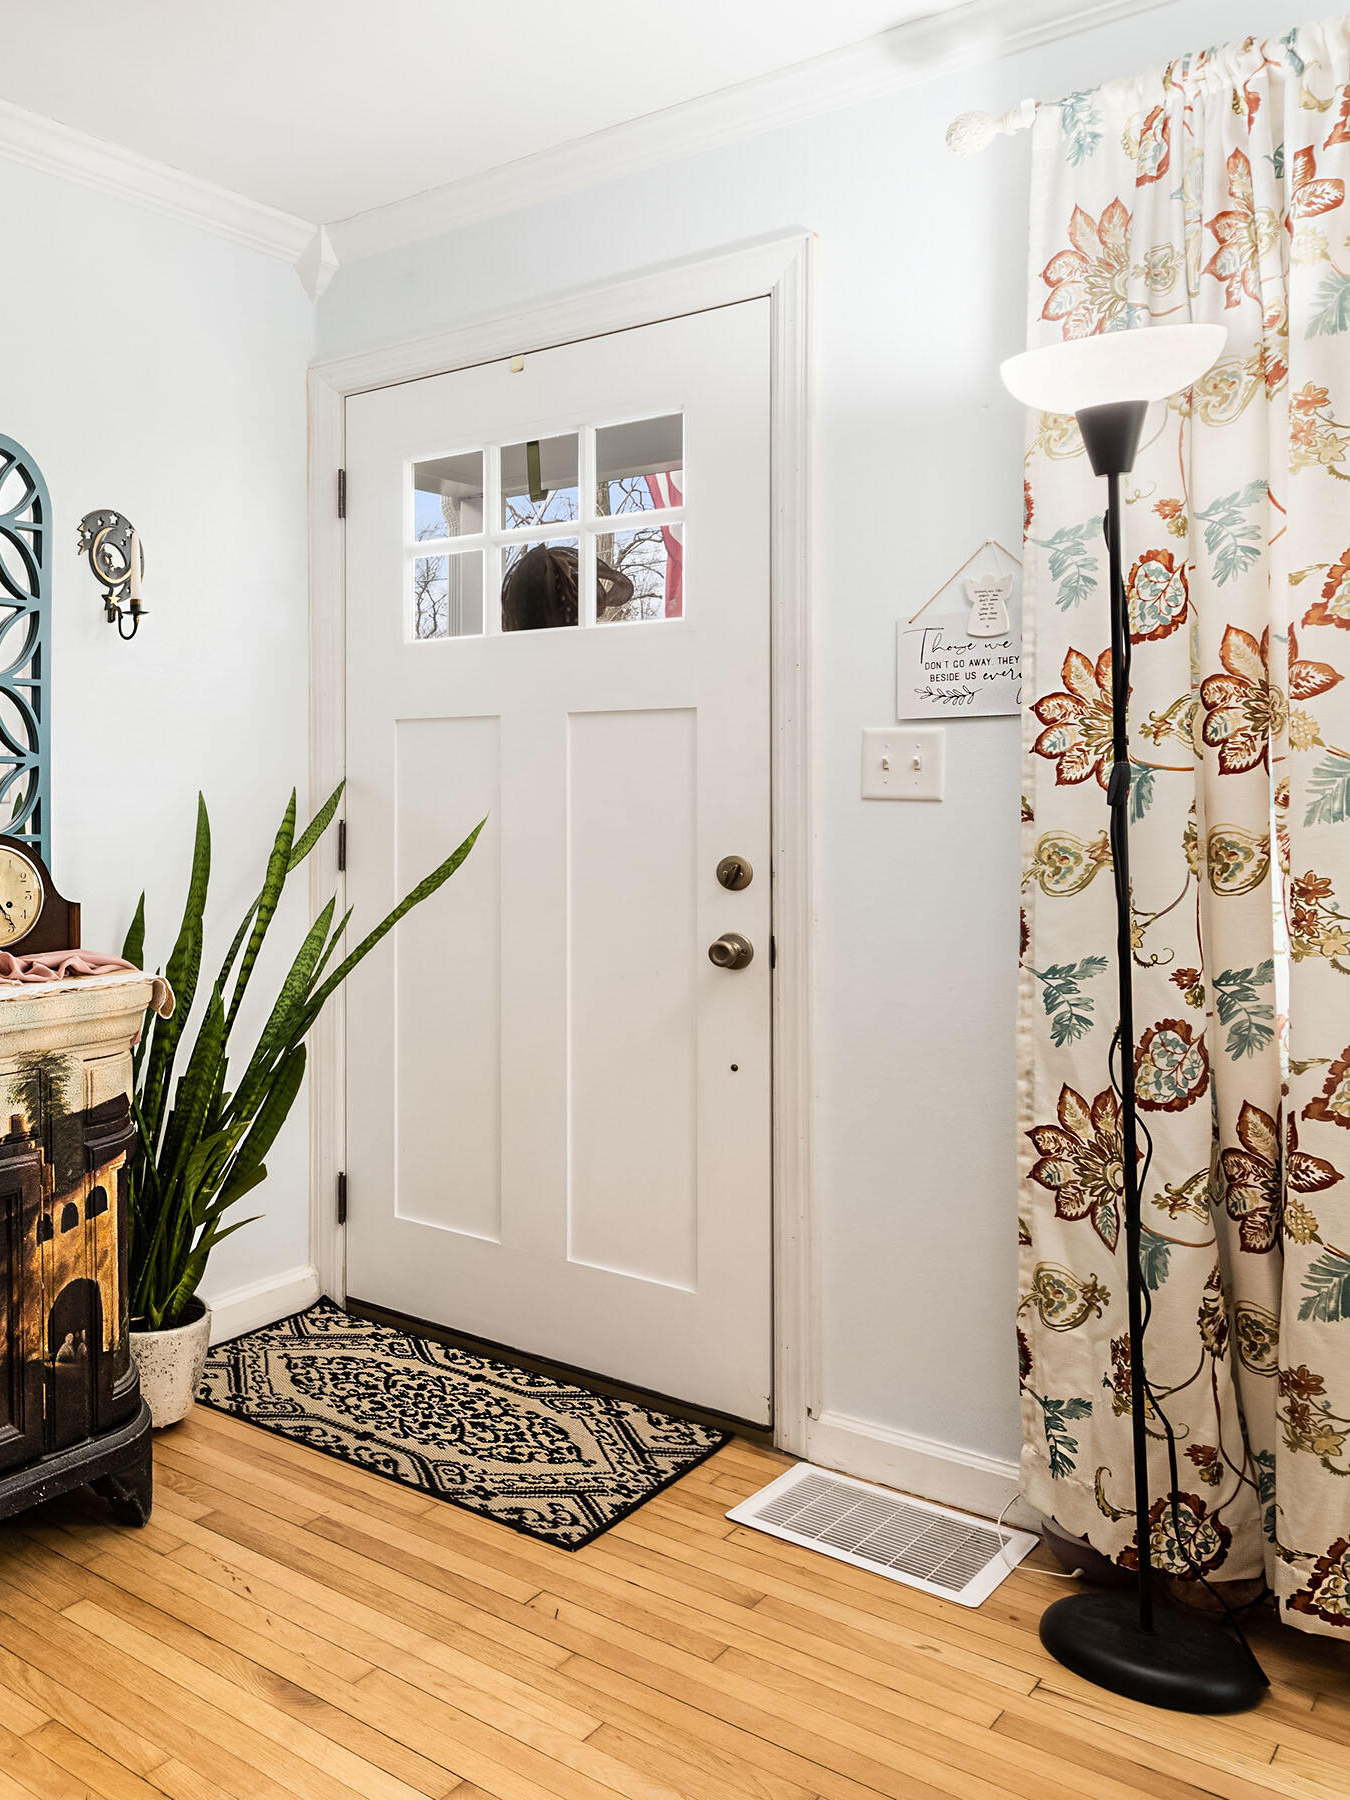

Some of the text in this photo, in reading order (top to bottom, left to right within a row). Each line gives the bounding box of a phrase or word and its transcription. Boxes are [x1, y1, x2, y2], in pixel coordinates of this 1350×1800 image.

[902, 627, 1013, 664] Those we
[924, 660, 950, 671] DON'T
[952, 659, 965, 668] GO
[997, 655, 1020, 665] THEY
[929, 672, 960, 683] BESIDE
[964, 671, 977, 681] US
[19, 872, 27, 883] 2
[24, 890, 32, 901] 3
[20, 909, 27, 920] 4
